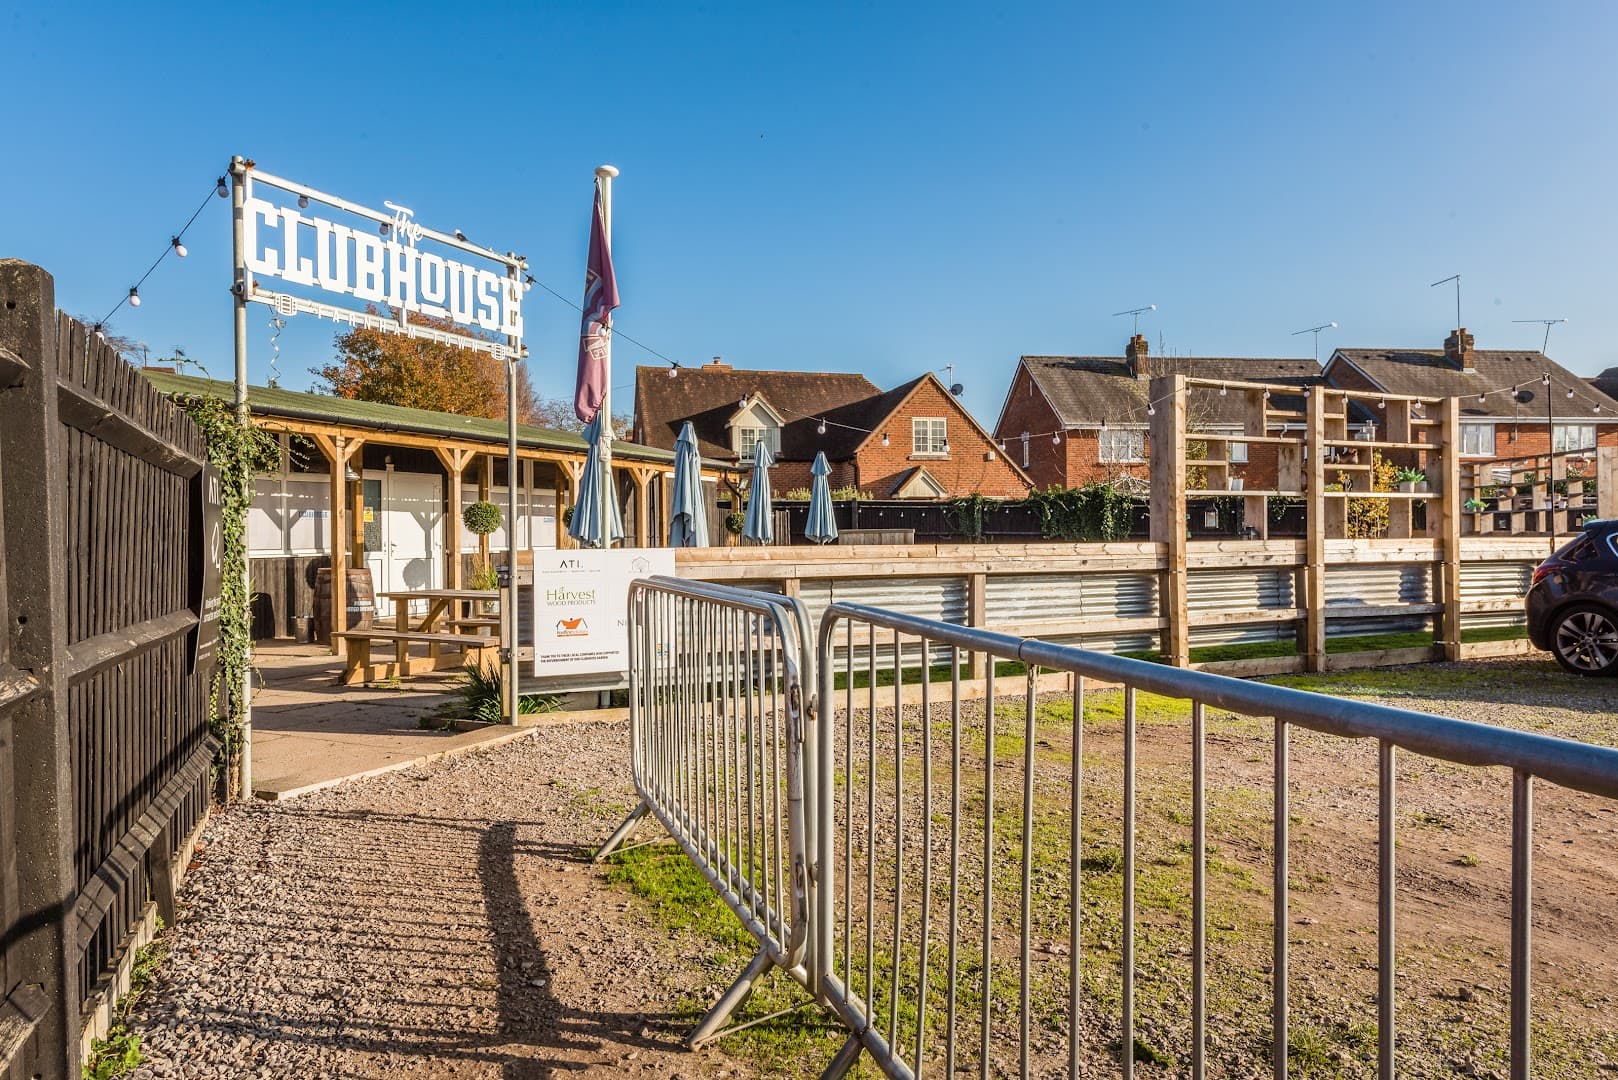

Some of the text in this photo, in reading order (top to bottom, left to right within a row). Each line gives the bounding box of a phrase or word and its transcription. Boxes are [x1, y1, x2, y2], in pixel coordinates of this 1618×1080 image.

[383, 200, 425, 242] The
[243, 197, 524, 338] CLUBHOUSE
[317, 304, 479, 353] FARNHAM TOWN
[546, 587, 596, 601] Harvest
